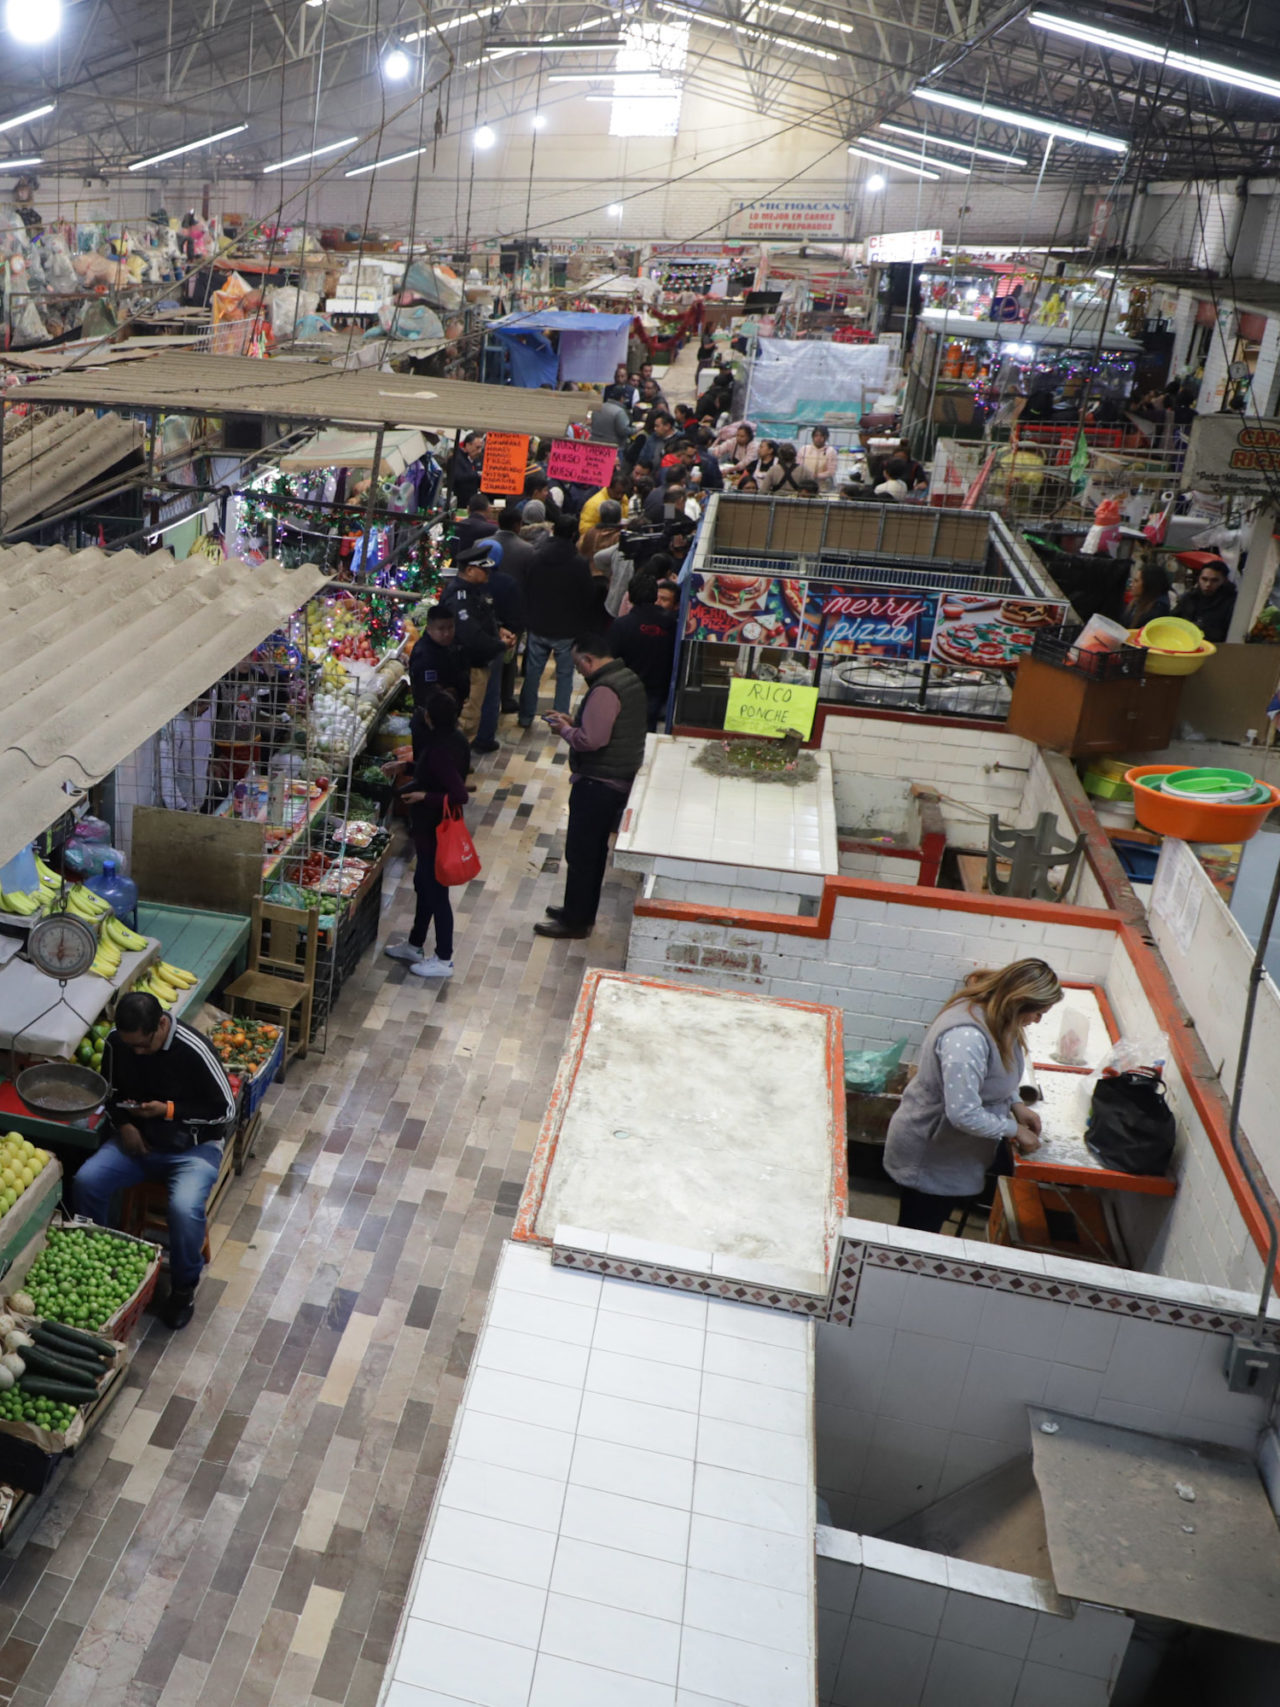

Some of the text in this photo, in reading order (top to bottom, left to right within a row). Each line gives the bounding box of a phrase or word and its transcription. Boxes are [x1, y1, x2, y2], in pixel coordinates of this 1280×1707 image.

[762, 213, 789, 221] MEJOR
[823, 596, 927, 627] merry
[823, 617, 913, 648] pizza
[747, 683, 792, 703] RICO
[740, 704, 789, 723] PONCHE
